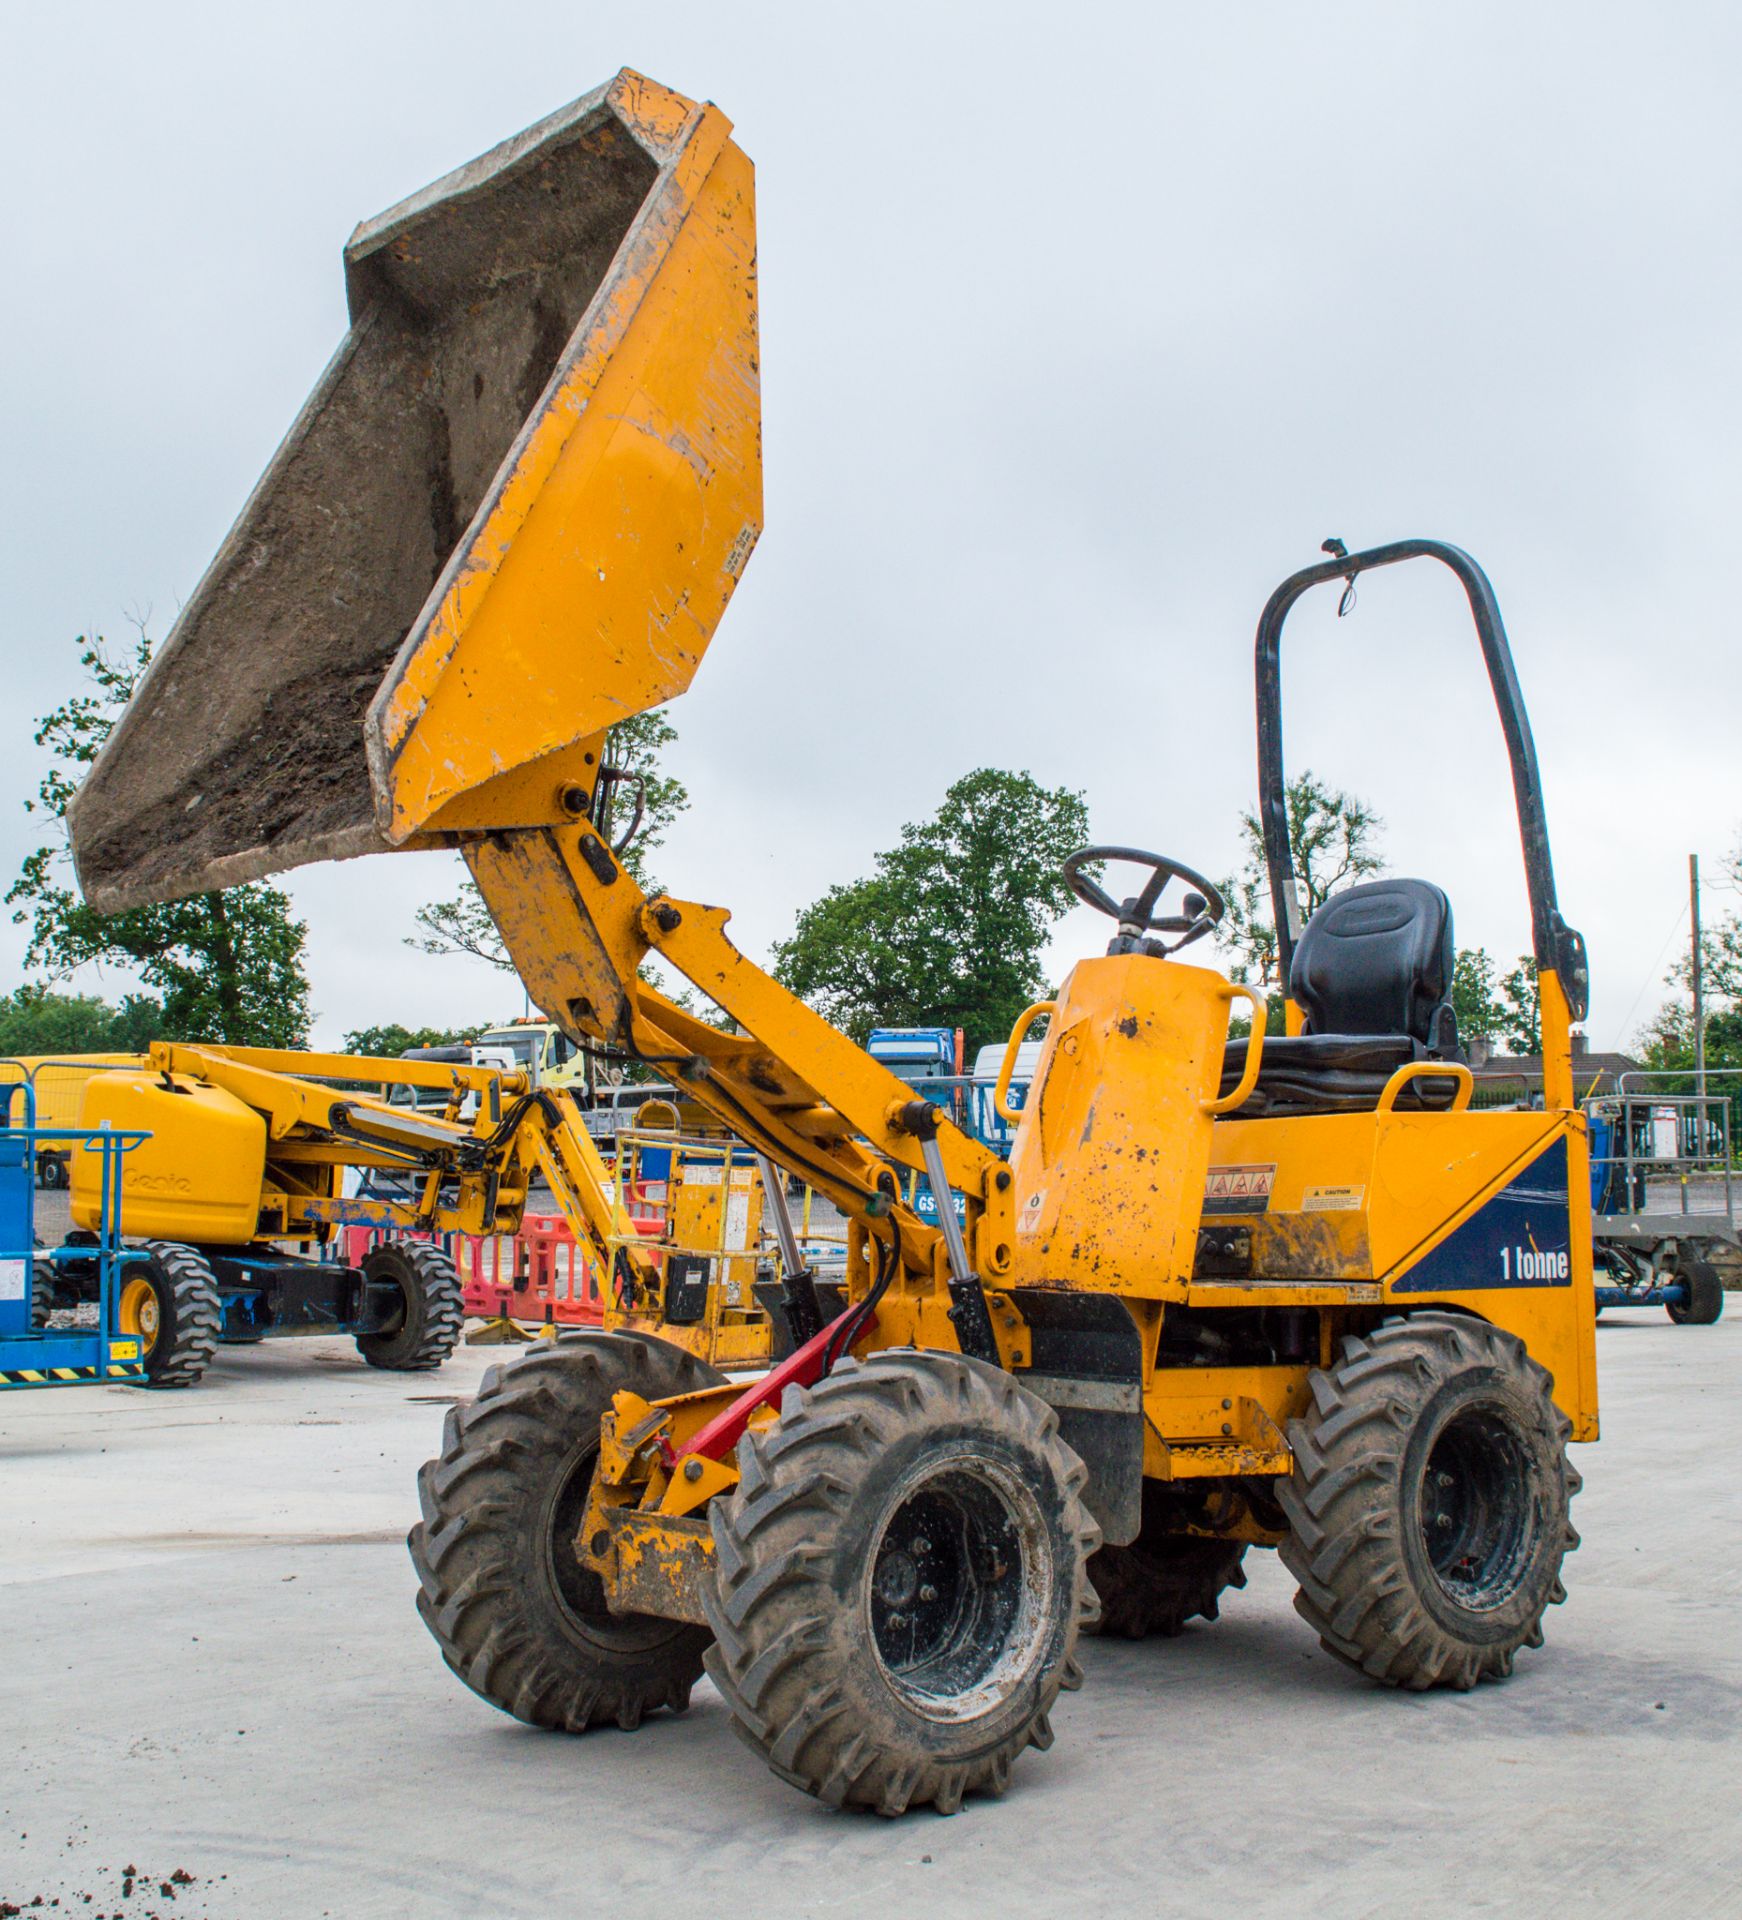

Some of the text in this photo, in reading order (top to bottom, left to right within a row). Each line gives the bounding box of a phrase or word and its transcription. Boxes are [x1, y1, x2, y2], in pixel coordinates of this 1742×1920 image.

[122, 1168, 191, 1196] Genie
[1324, 1188, 1351, 1196] CAUTION
[1500, 1246, 1569, 1280] 1 tonne
